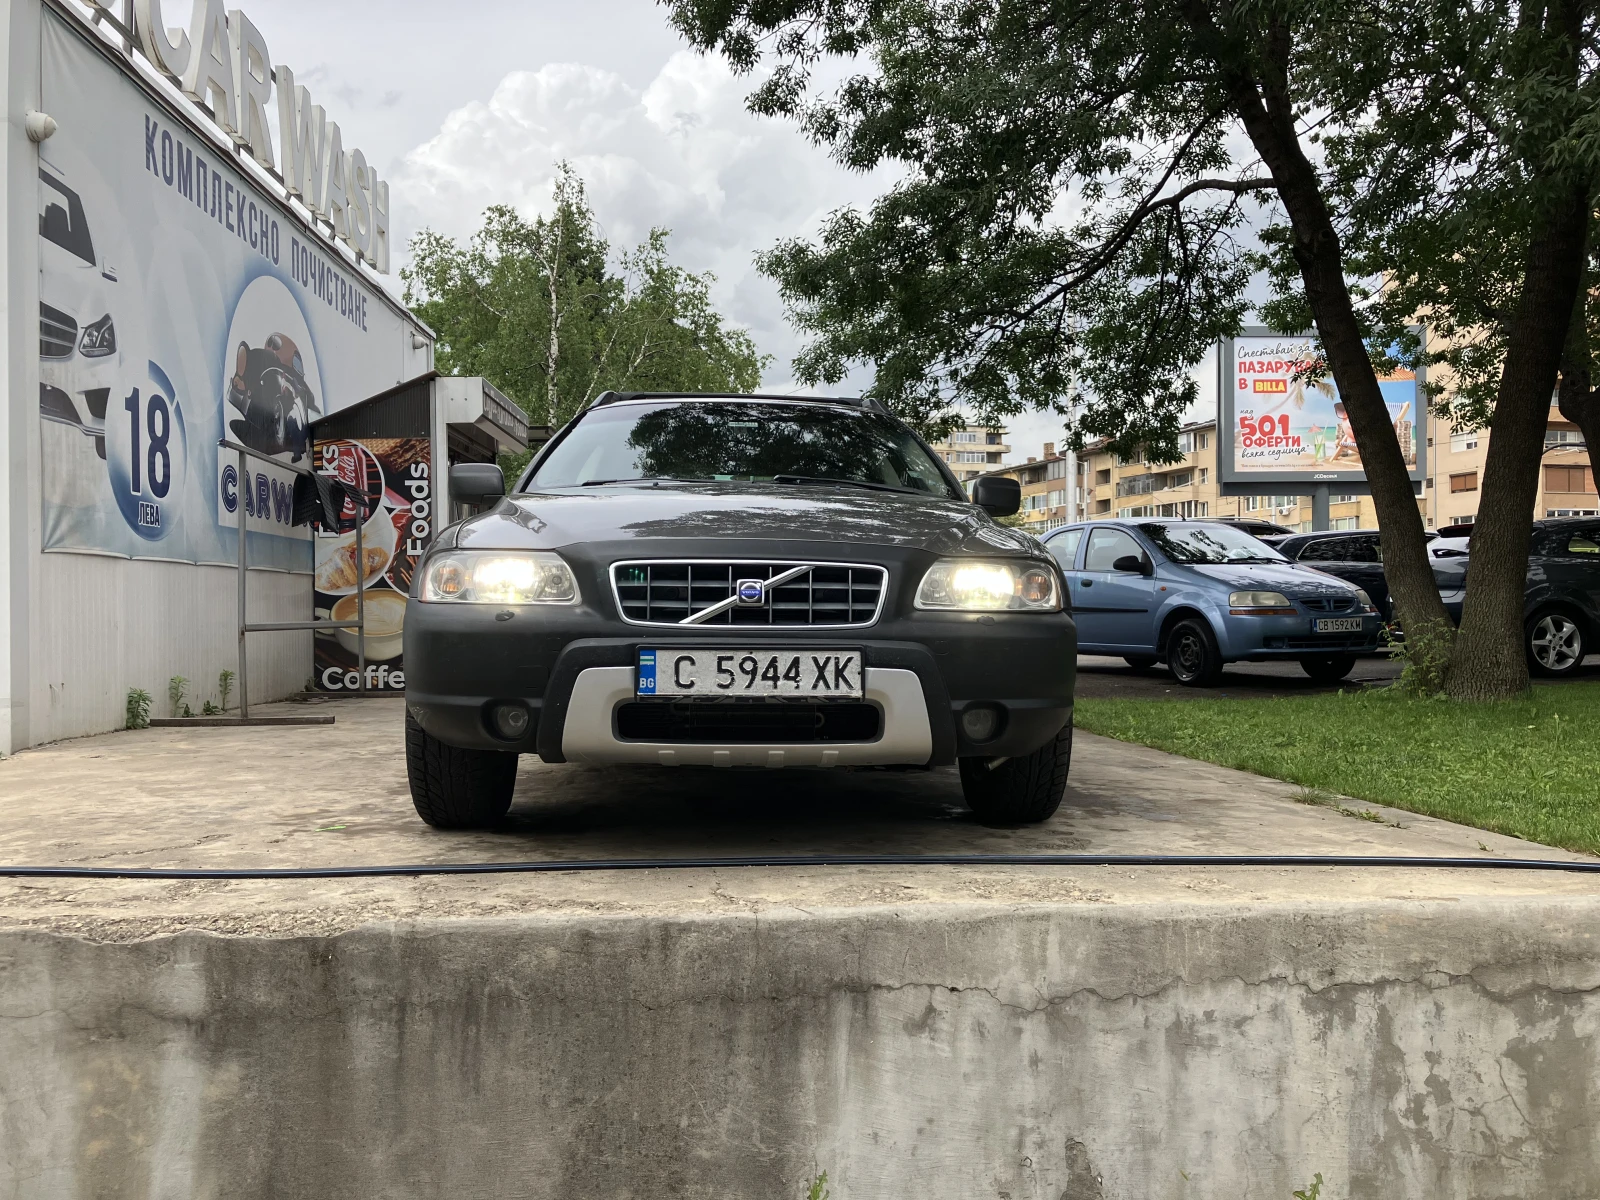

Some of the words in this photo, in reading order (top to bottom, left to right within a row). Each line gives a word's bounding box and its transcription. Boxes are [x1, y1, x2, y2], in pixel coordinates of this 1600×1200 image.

[275, 65, 390, 275] WASH
[144, 114, 281, 266] КОМПЛЕКСНО
[291, 236, 368, 333] ПОЧИСТВАНЕ
[1255, 382, 1285, 391] BILLA
[1240, 414, 1289, 437] 501
[125, 387, 170, 498] 18
[1243, 436, 1301, 447] ОФЕРТИ
[221, 465, 295, 526] CARW
[139, 502, 160, 527] ЛЕВА
[405, 462, 430, 556] Foods
[1330, 620, 1350, 631] 1592
[321, 664, 405, 690] Coffe
[639, 677, 655, 688] BG
[716, 655, 802, 690] 5944
